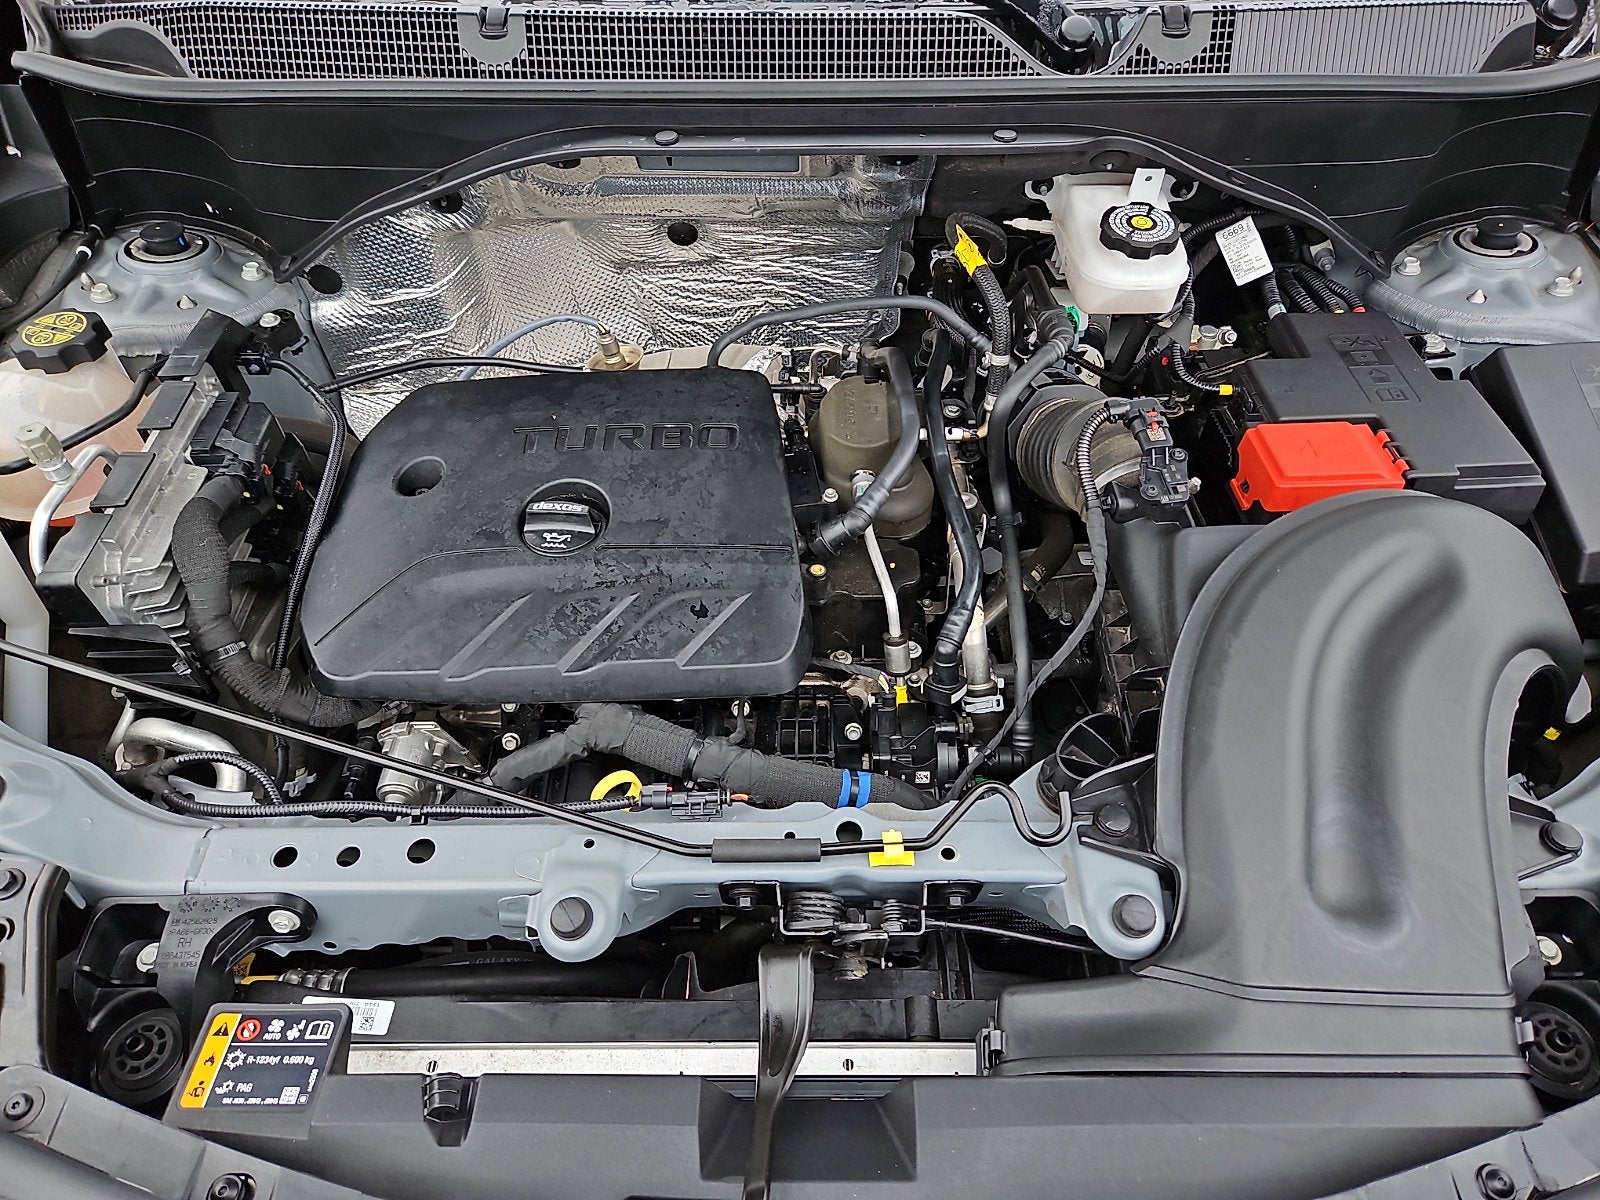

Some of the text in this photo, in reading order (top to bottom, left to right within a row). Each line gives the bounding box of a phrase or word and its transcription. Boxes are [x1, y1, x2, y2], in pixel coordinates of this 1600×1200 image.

[1222, 223, 1244, 239] 6669
[513, 422, 740, 453] TURBO
[532, 501, 583, 512] dexos
[177, 938, 192, 948] RH
[262, 1032, 282, 1041] AUTO
[246, 1055, 315, 1066] R-1234yf 0.600 kg
[235, 1082, 253, 1093] PAG
